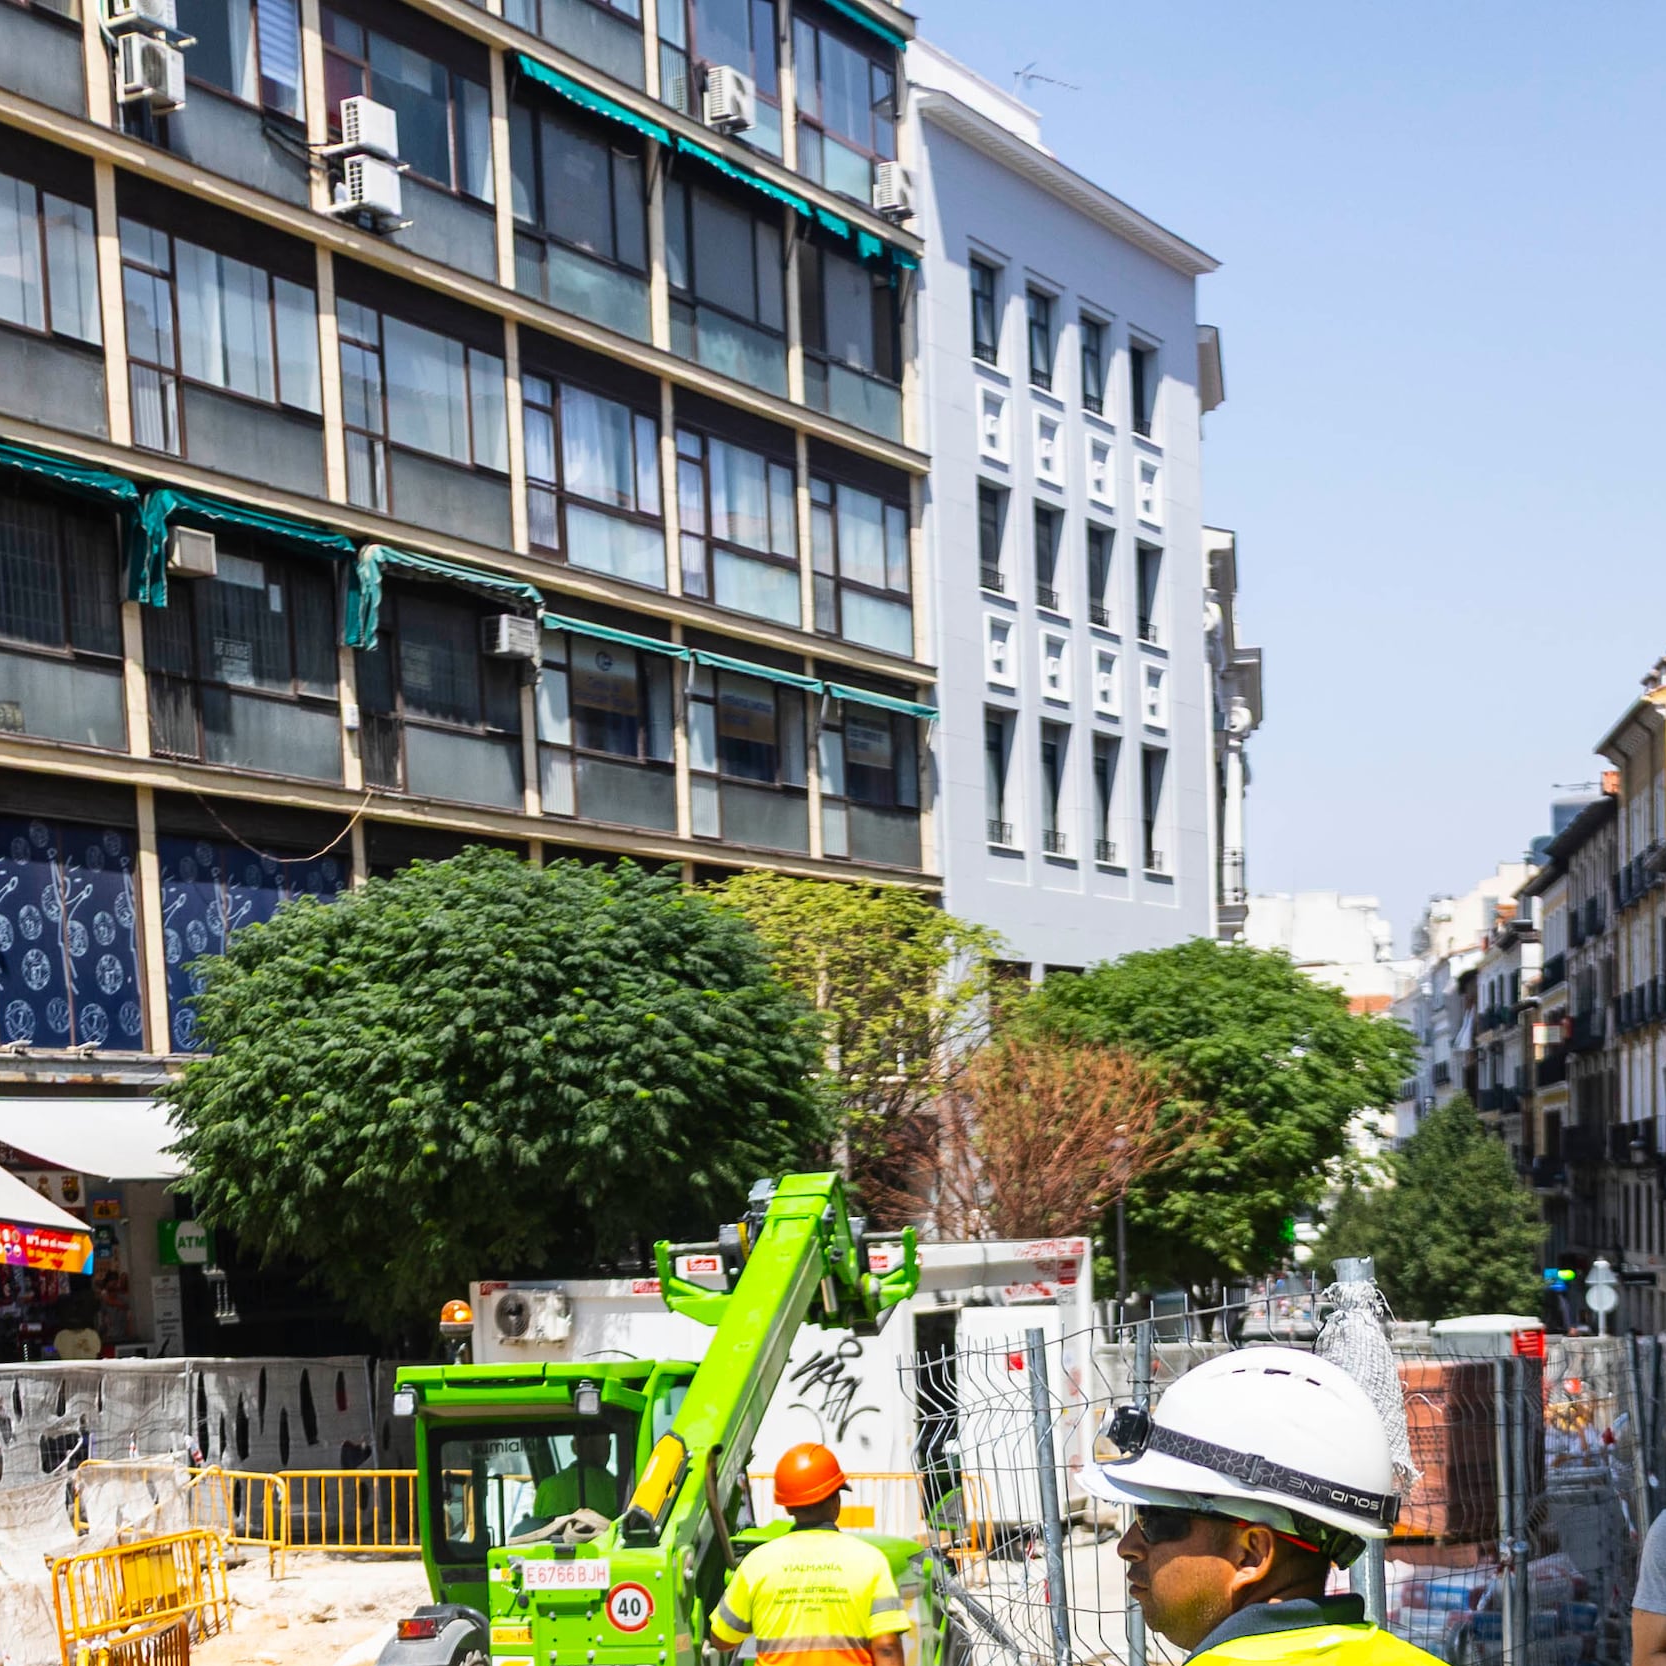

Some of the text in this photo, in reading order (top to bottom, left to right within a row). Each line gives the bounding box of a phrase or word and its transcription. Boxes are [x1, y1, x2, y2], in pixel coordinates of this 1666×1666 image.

[178, 1236, 206, 1248] ATM
[1288, 1476, 1379, 1511] SOLIDLINE
[618, 1598, 641, 1617] 40
